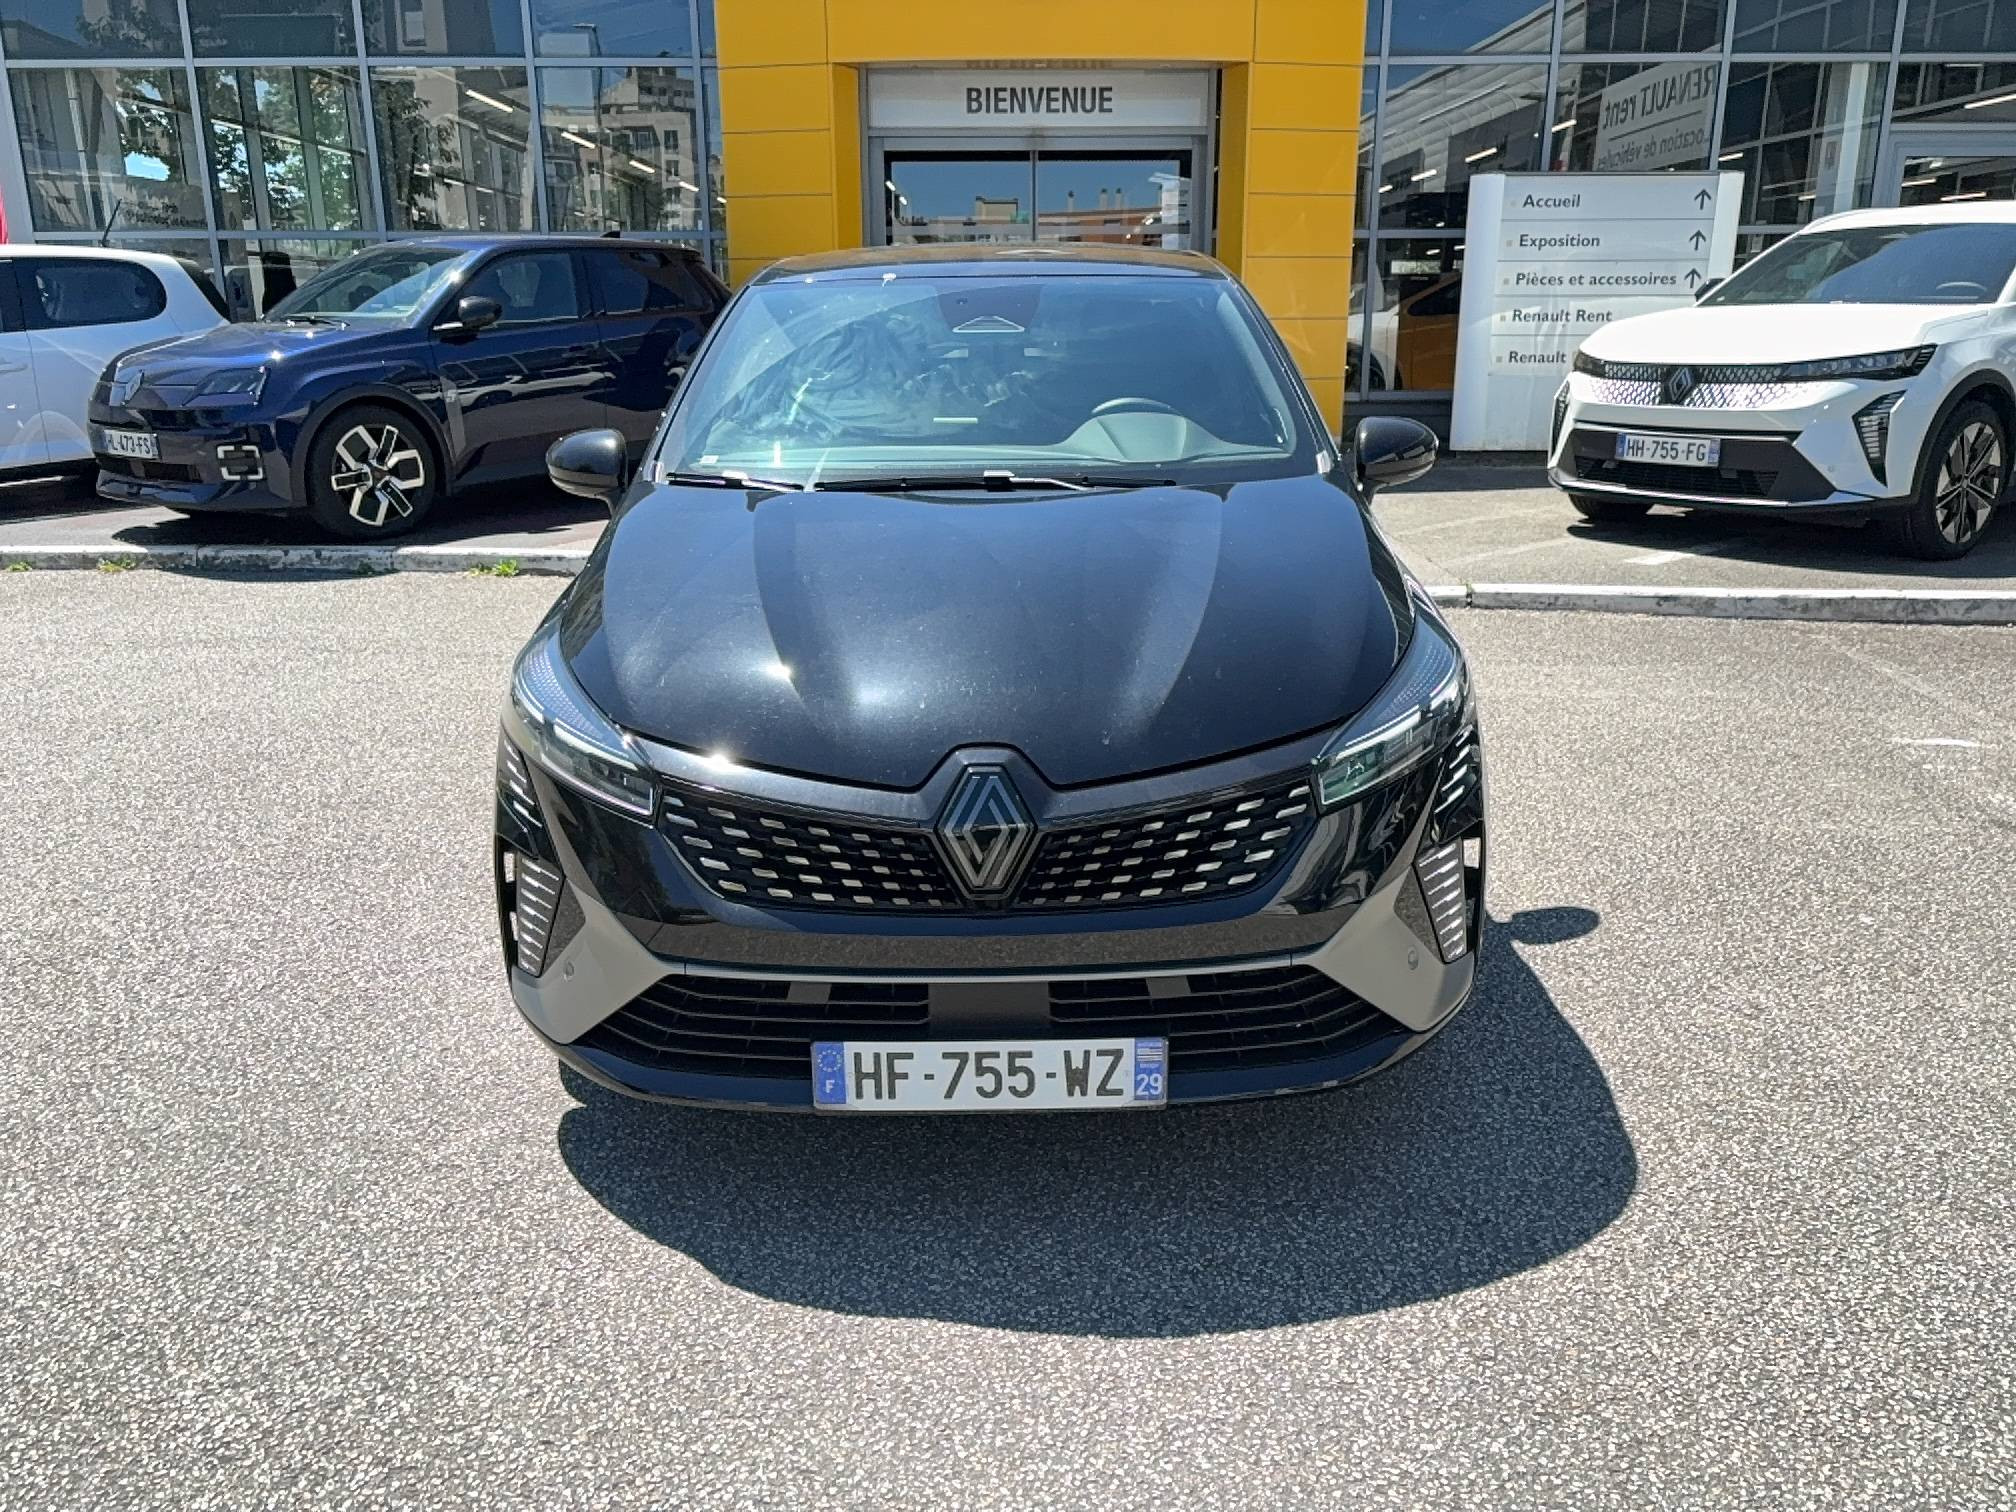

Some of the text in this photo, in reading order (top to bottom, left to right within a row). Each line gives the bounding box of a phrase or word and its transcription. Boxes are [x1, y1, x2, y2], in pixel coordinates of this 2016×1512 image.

[966, 86, 1113, 114] BIENVENUE
[1522, 193, 1581, 208] Accueil
[1519, 233, 1600, 251] Exposition
[1515, 271, 1677, 286] Pièces et accessoires
[1511, 309, 1613, 322] Renault Rent
[1508, 350, 1567, 363] Renault
[1626, 439, 1707, 462] HH-755-FG
[853, 1049, 1124, 1100] HF-755-WZ
[825, 1079, 836, 1094] F
[1136, 1073, 1162, 1096] 29
